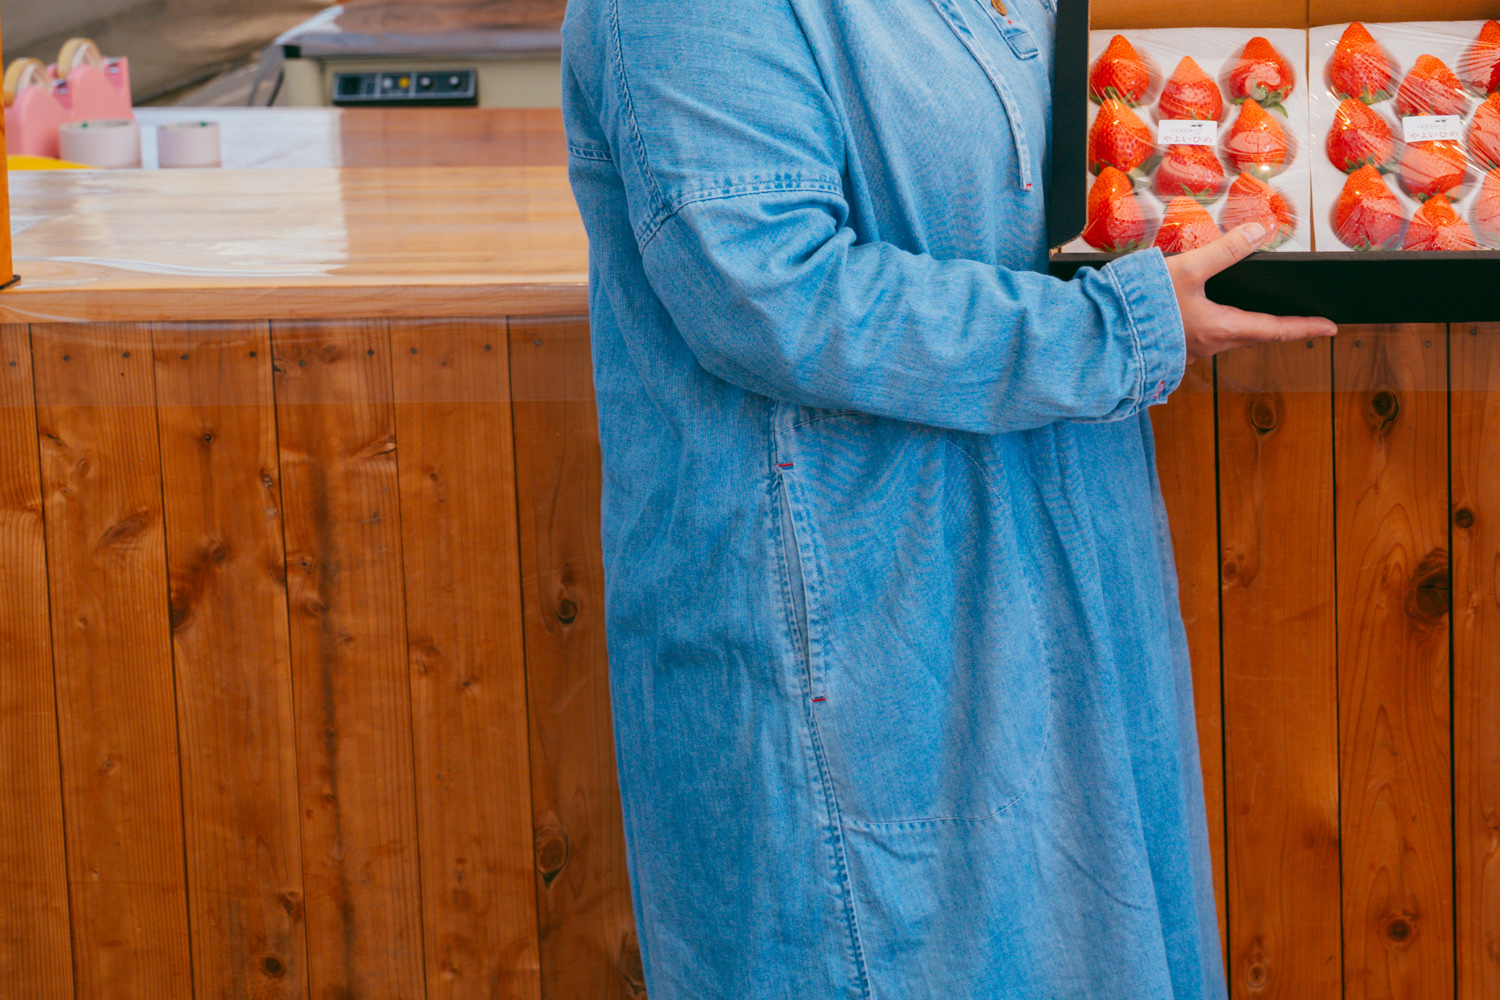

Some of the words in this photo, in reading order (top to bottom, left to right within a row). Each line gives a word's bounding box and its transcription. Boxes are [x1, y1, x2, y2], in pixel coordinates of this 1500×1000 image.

[1163, 135, 1213, 143] やよいひめ
[1410, 130, 1459, 140] やよいひめ
